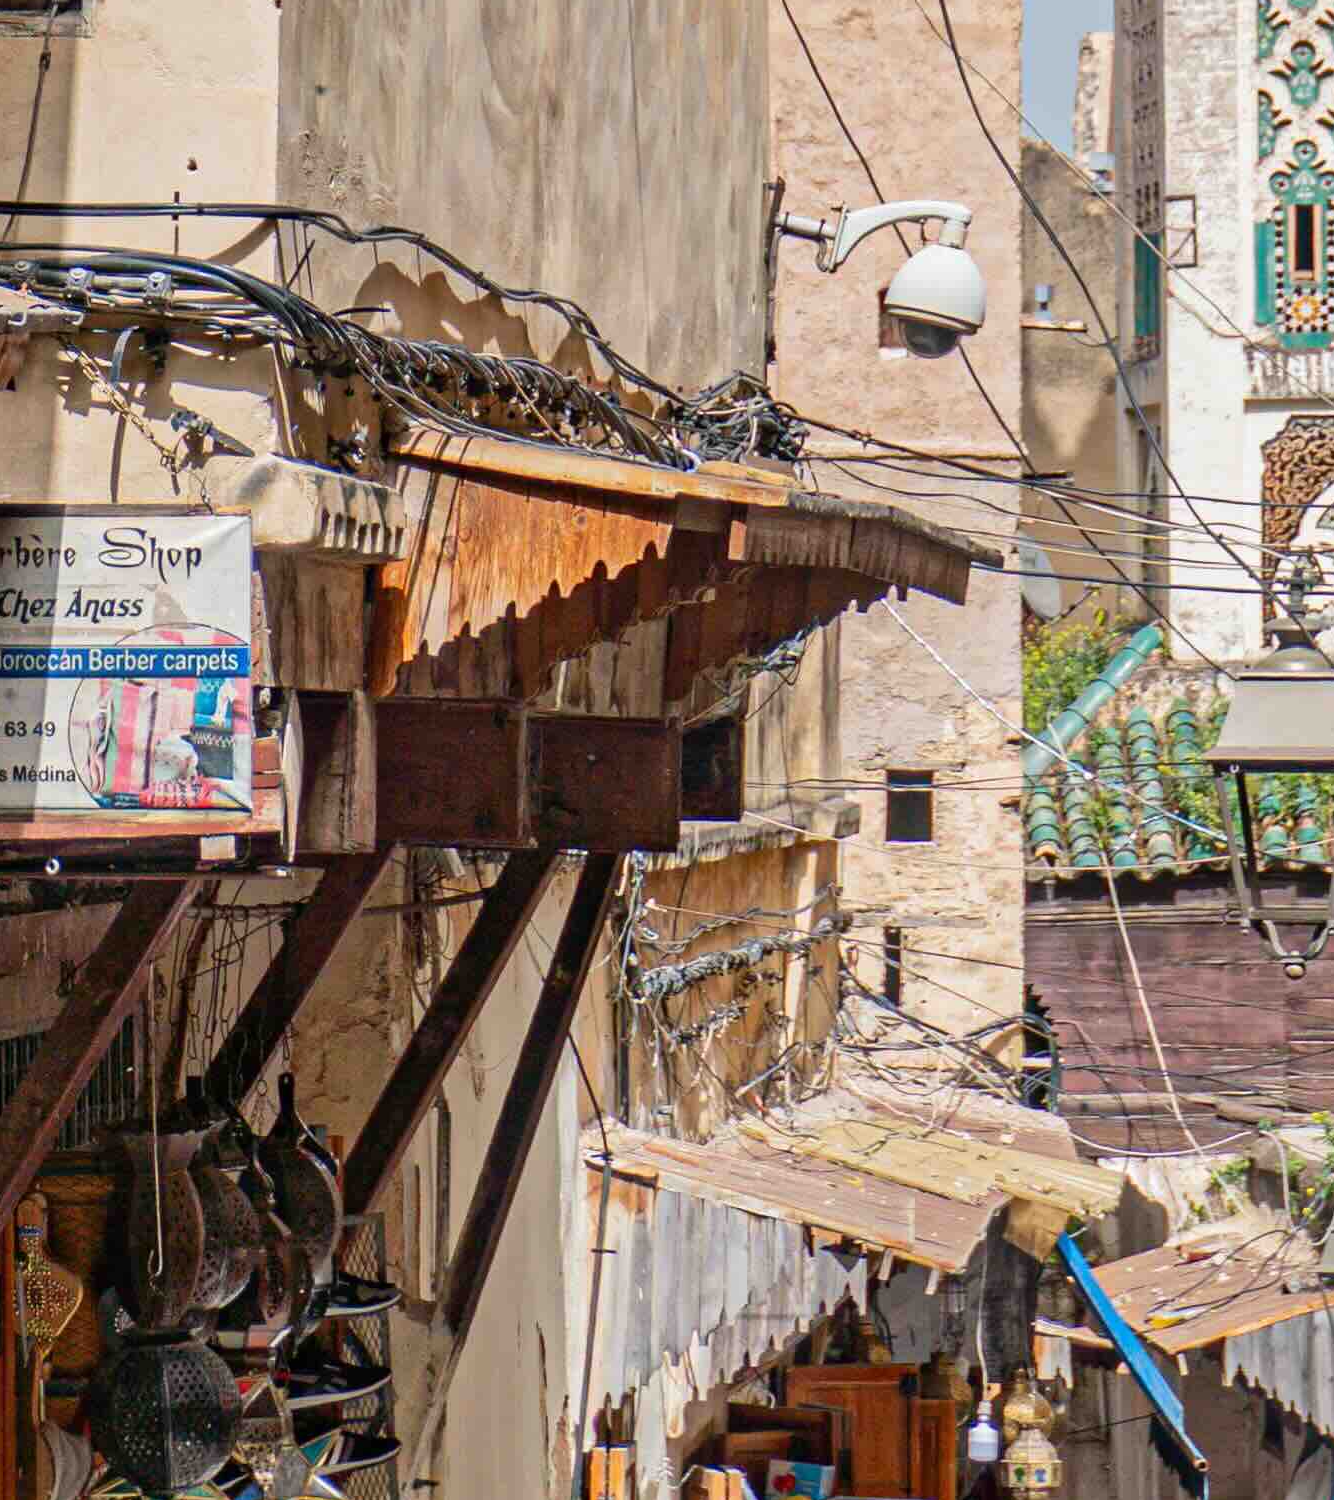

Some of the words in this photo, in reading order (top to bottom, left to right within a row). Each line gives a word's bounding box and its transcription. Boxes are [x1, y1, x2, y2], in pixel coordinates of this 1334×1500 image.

[98, 527, 202, 584] Shop
[66, 588, 144, 624] Anass
[89, 649, 158, 672] Berber
[163, 649, 239, 676] carpets
[4, 721, 27, 738] 63
[33, 721, 56, 738] 49
[13, 765, 76, 782] Médina
